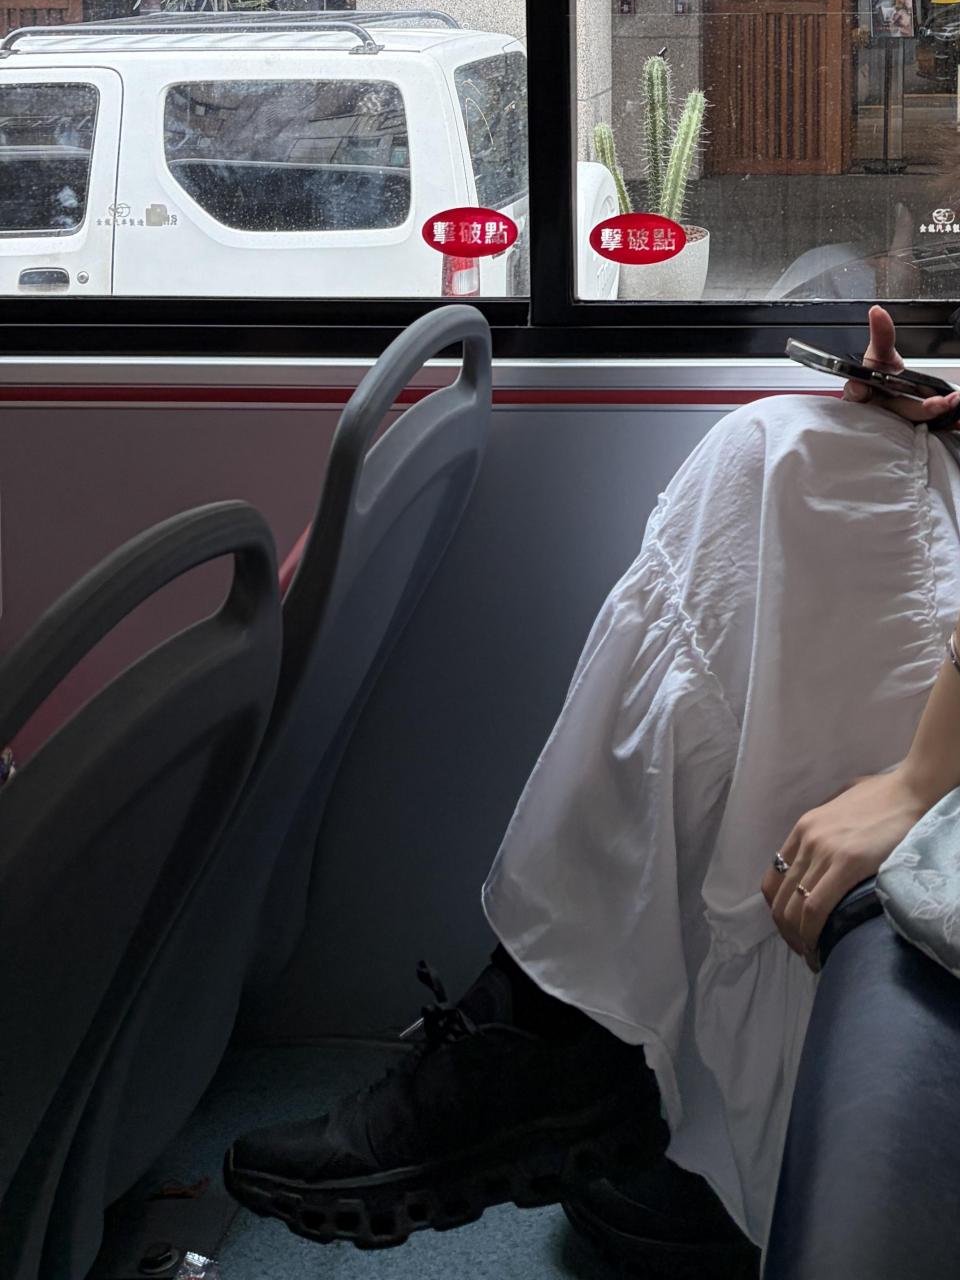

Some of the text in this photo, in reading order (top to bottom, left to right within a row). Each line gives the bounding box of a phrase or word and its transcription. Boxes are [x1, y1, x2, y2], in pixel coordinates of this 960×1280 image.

[433, 221, 509, 245] 擊破點
[600, 228, 676, 251] 擊破點
